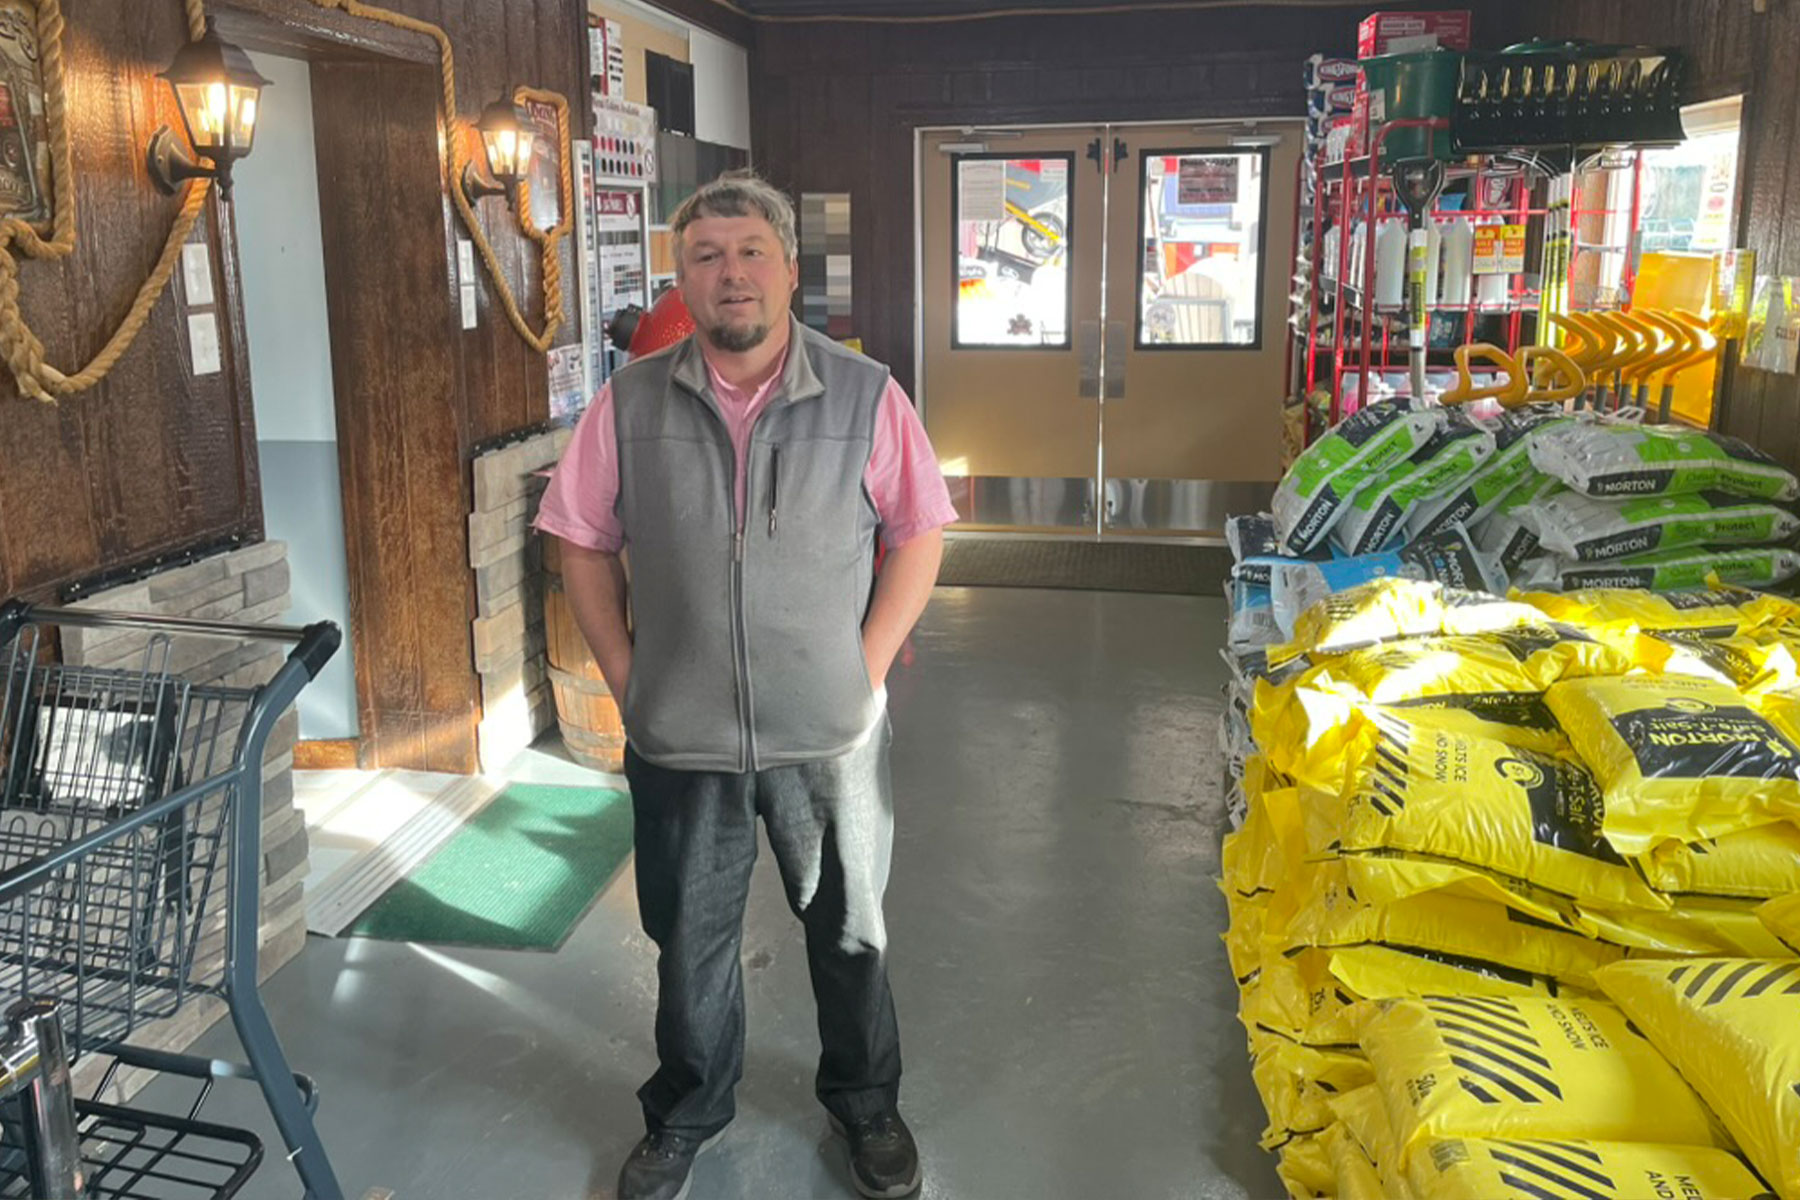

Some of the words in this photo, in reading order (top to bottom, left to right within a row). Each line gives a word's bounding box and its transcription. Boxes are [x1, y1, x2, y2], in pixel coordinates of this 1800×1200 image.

[1605, 480, 1656, 491] MORTON
[1299, 498, 1333, 542] MORTON
[1364, 512, 1395, 553] MORTON
[1595, 537, 1648, 558] MORTON
[1582, 576, 1640, 590] MORTON
[1649, 720, 1767, 734] Safe-T-Salt
[1649, 732, 1762, 748] MORTON
[1557, 1020, 1587, 1050] SNOW
